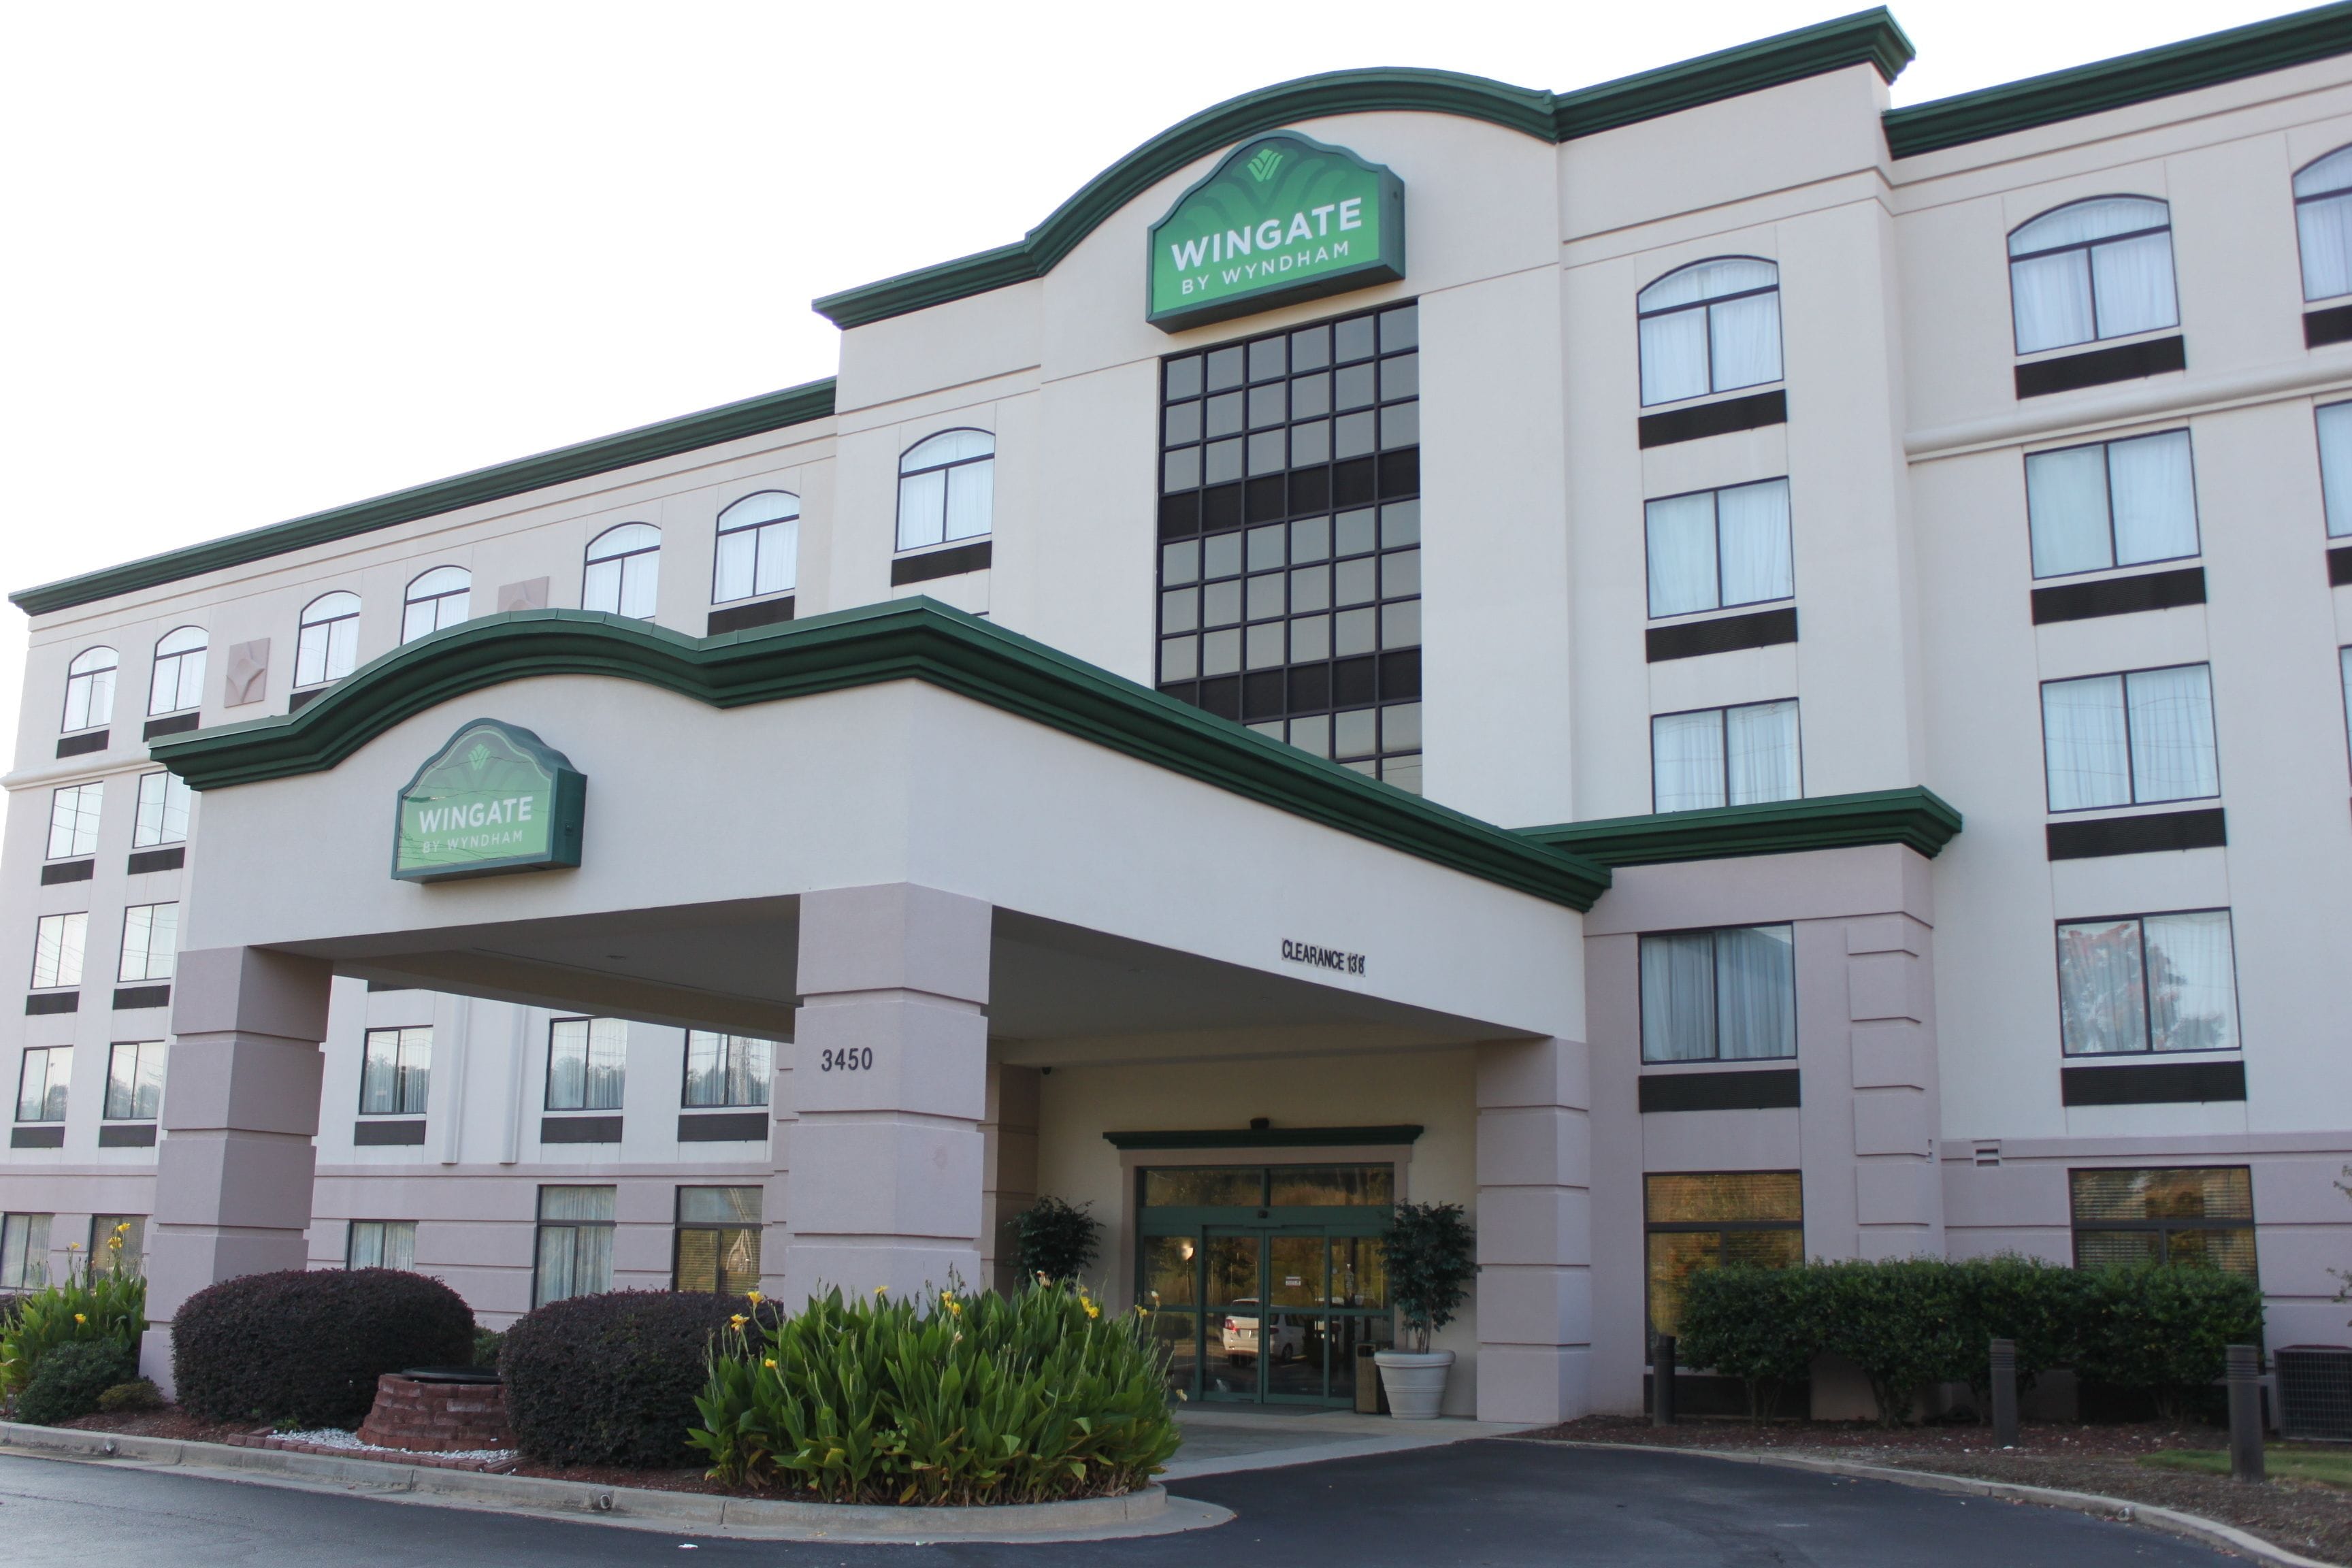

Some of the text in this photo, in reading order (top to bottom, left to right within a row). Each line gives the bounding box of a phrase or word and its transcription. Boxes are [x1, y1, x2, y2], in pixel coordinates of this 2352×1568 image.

[1171, 197, 1362, 271] WINGATE
[1182, 240, 1349, 295] BY WYNDHAM
[419, 796, 533, 834] WINGATE
[423, 830, 523, 853] BY WYNDHAM
[1282, 939, 1344, 970] CLEARANCE
[821, 1047, 872, 1072] 3450
